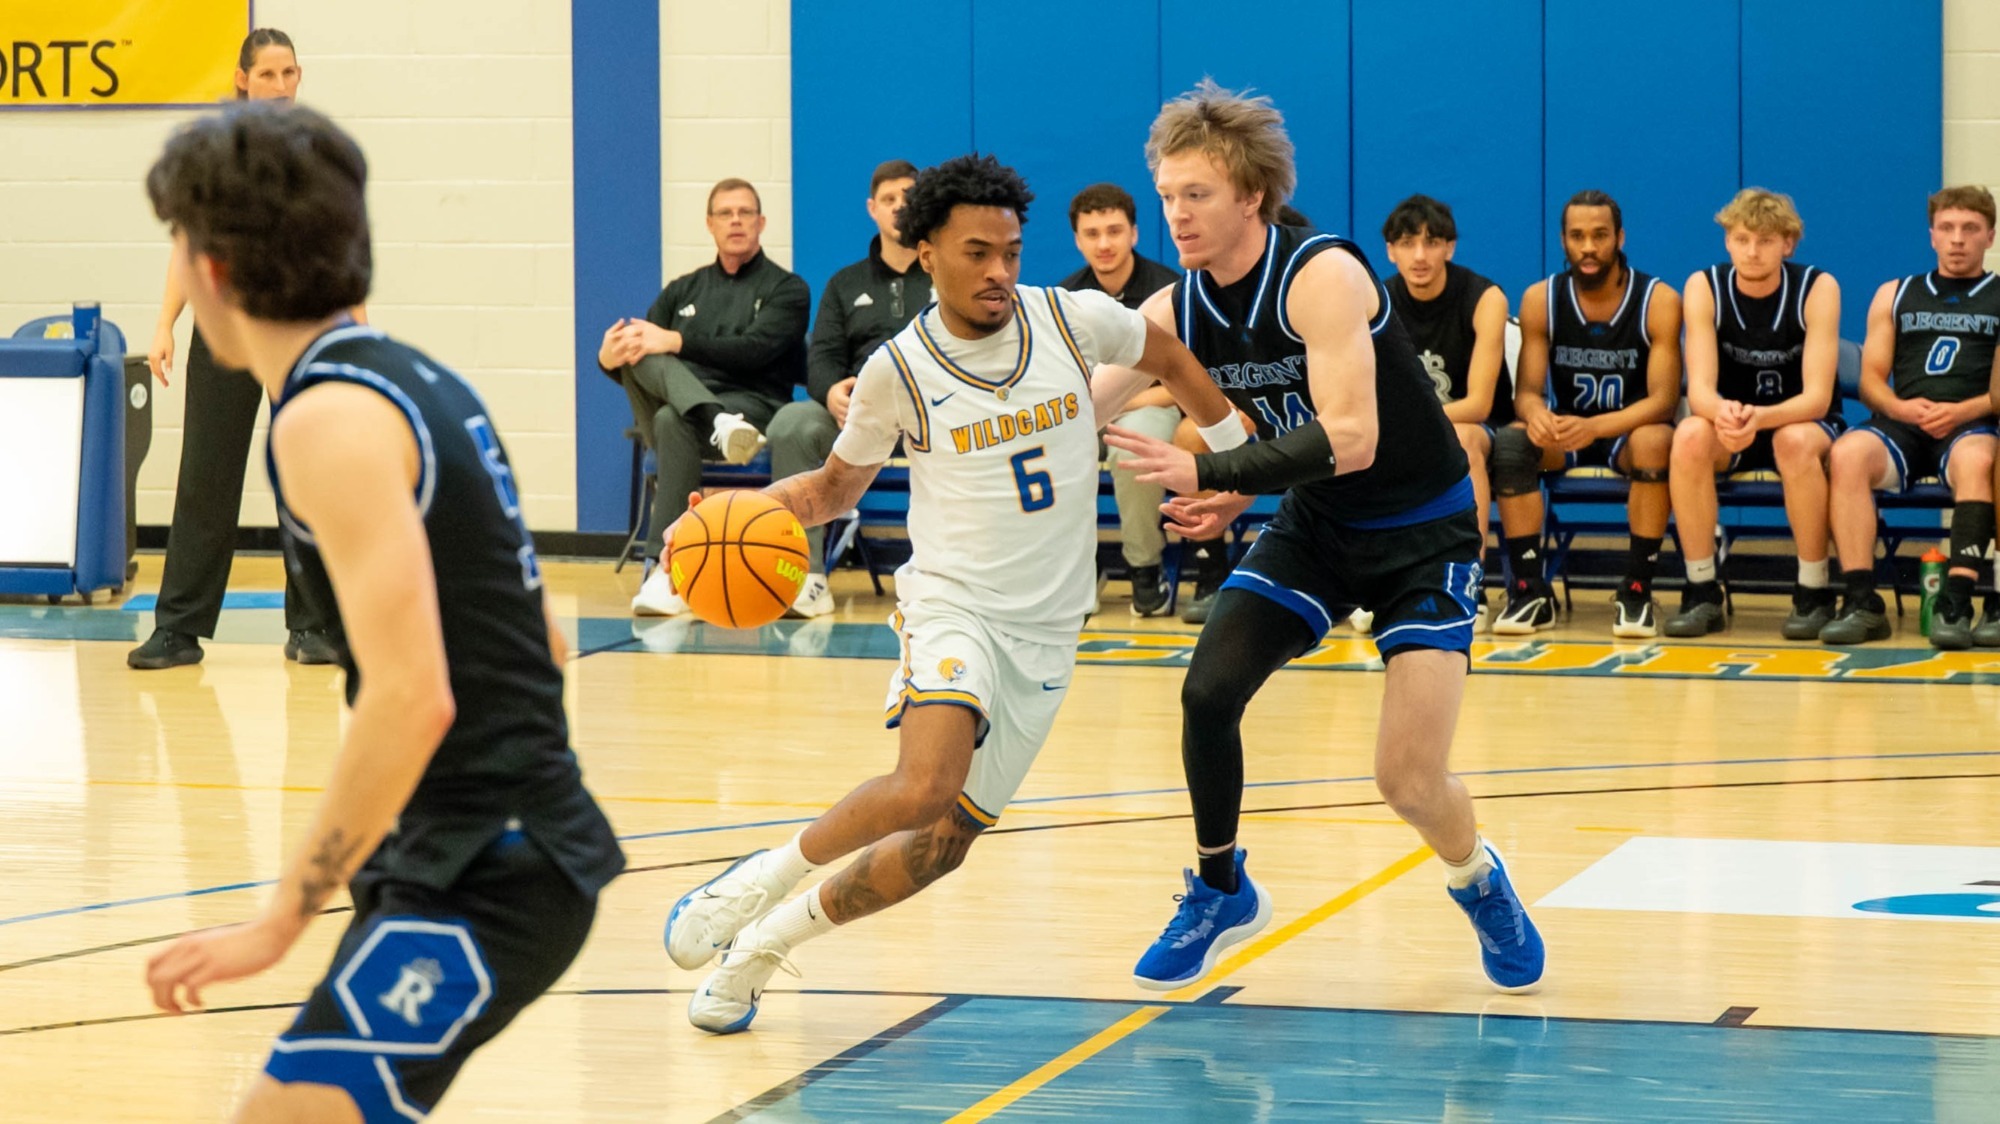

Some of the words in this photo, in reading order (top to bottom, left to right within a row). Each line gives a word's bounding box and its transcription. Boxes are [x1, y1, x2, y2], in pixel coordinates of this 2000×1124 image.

[0, 40, 119, 97] RTS
[1901, 311, 1999, 335] REGENT
[1555, 346, 1638, 369] REGENT
[1925, 336, 1960, 375] 0
[1573, 373, 1624, 410] 20
[950, 393, 1080, 455] WILDCATS
[1252, 392, 1315, 439] 14
[1008, 445, 1056, 514] 6
[378, 964, 436, 1027] R
